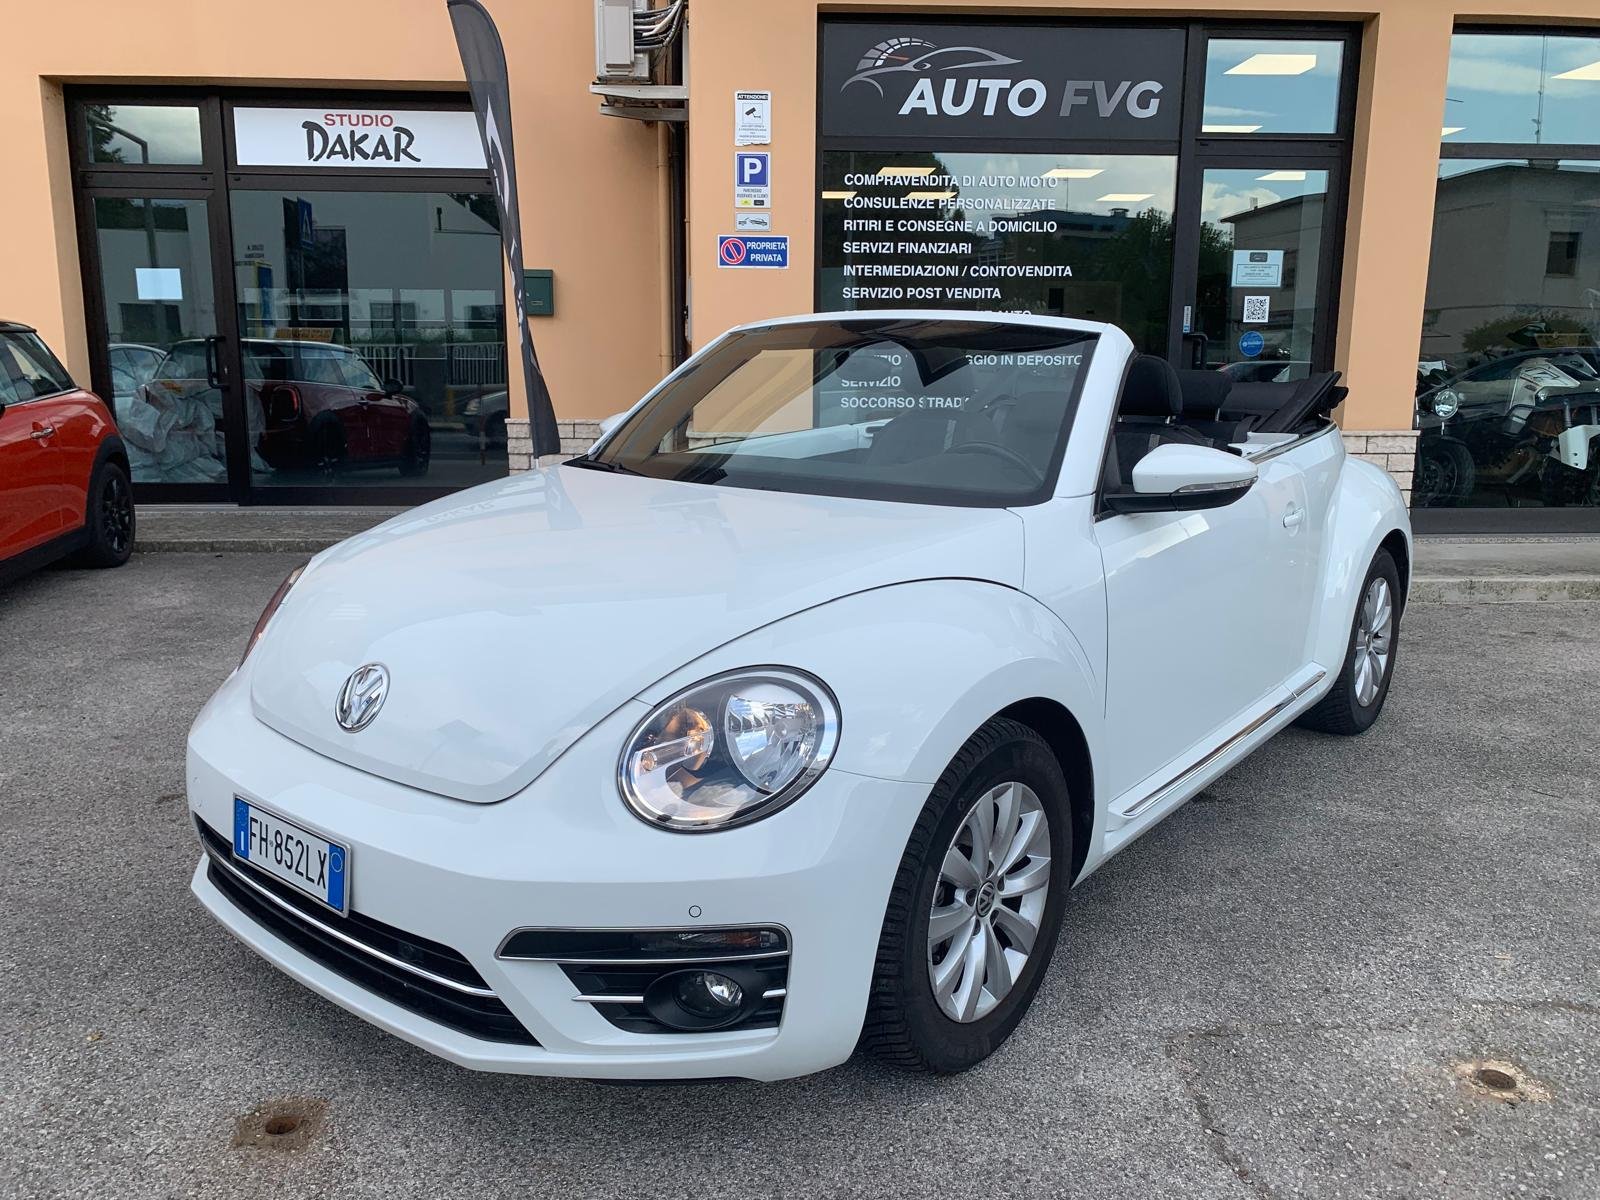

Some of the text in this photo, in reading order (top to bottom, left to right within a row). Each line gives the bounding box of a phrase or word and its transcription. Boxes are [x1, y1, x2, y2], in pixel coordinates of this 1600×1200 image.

[898, 78, 1163, 119] AUTO FVG
[324, 113, 394, 127] STUDIO
[301, 120, 422, 163] DAKAR
[743, 157, 763, 183] P
[843, 173, 1058, 189] COMPRAVENDITA DI AUTO MOTO
[843, 196, 1056, 211] CONSULENZE PERSONALIZZATE
[843, 220, 1058, 234] RITIRI E CONSEGNE A DOMICILIO
[842, 242, 972, 255] SERVIZI FINANZIARI
[750, 253, 783, 262] PRIVATA
[843, 265, 960, 277] INTERMEDIAZIONI
[969, 265, 1073, 278] CONTOVENDITA
[842, 288, 1002, 300] SERVIZIO POST VENDITA
[1000, 355, 1013, 366] IN
[840, 397, 915, 409] SOCCORSO
